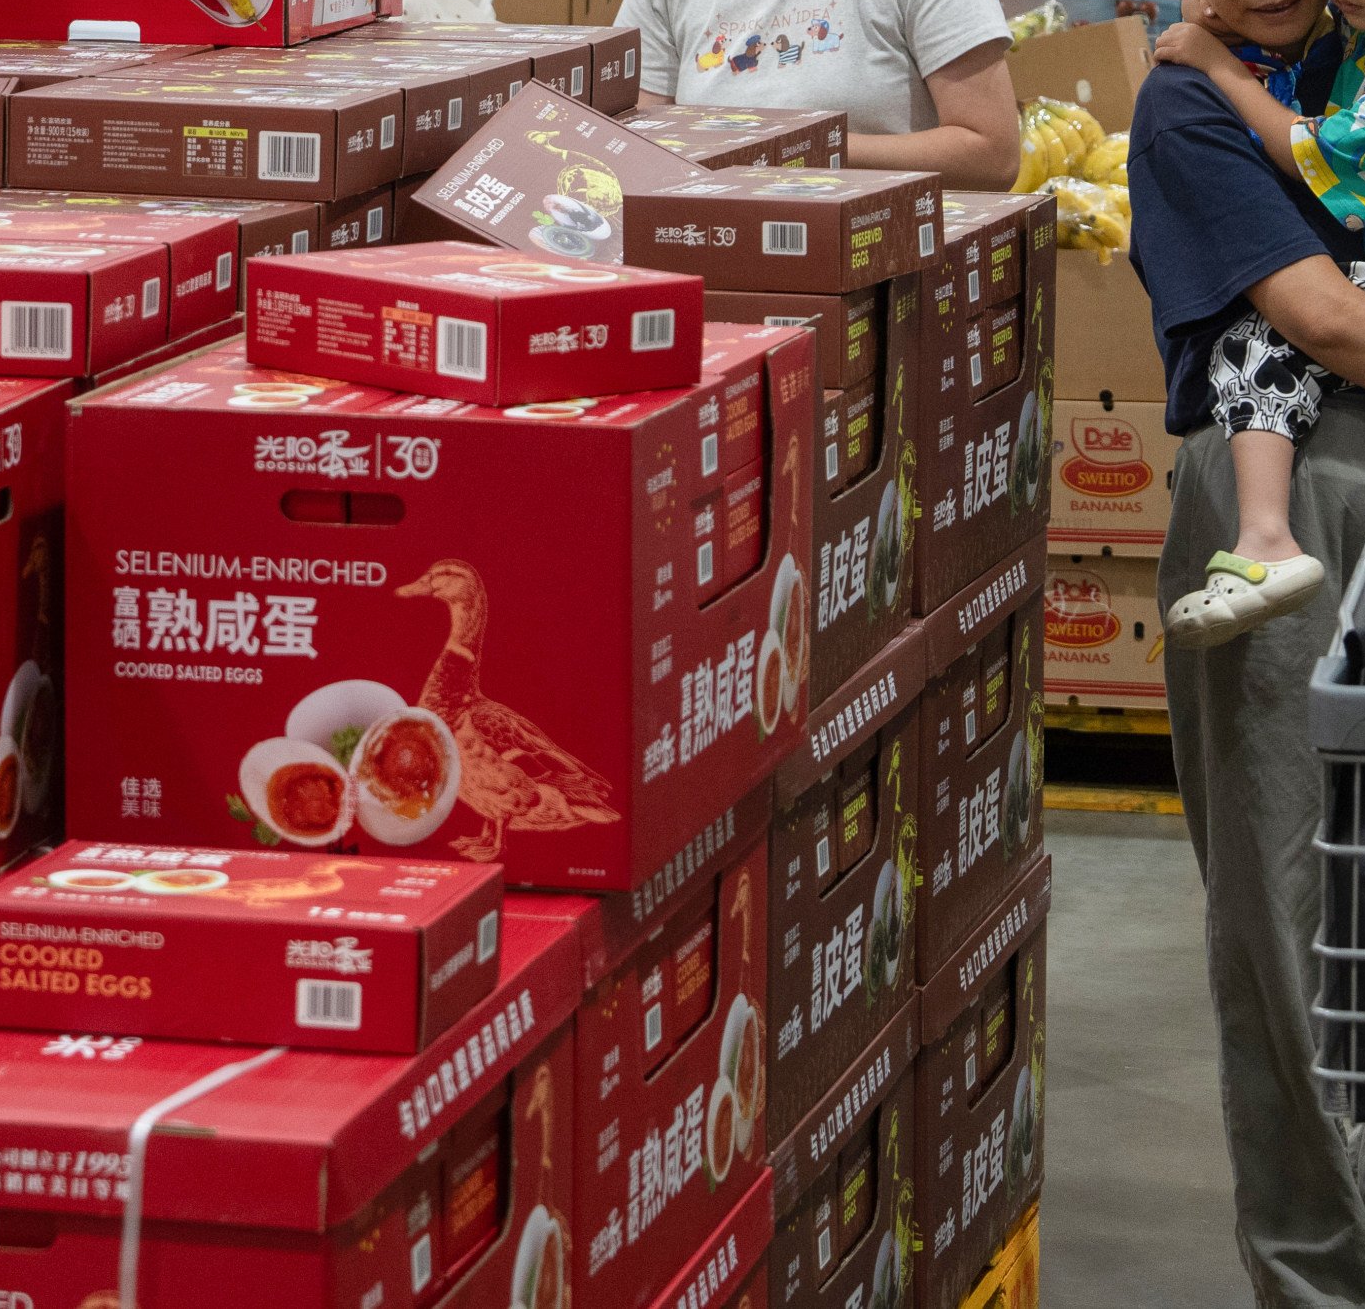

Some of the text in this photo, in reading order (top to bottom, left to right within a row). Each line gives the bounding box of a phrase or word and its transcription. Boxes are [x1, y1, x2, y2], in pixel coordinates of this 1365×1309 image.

[770, 14, 791, 29] AN
[795, 7, 831, 24] IDEA
[435, 137, 505, 201] SELENIUM-ENRICHED
[851, 226, 883, 250] PRESERVED
[851, 251, 870, 270] EGGS
[991, 244, 1013, 265] PRESERVED
[991, 264, 1005, 283] EGGS
[847, 318, 870, 341] PRESERVED
[848, 341, 861, 362] EGGS
[993, 346, 1006, 366] EGGS
[847, 413, 869, 440] PRESERVED
[1083, 424, 1133, 450] Dole
[847, 437, 861, 459] EGGS
[255, 458, 316, 472] GOOSUN
[962, 420, 1011, 521] 富硒皮蛋
[1078, 469, 1138, 488] SWEETIO
[1070, 499, 1143, 513] BANANAS
[115, 549, 387, 587] SELENIUM-ENRICHED
[817, 514, 871, 633] 富硒皮蛋
[957, 558, 1028, 636] 与出口欧盟蛋品同品质
[112, 585, 319, 659] 富硒熟咸蛋
[1045, 620, 1105, 638] SWEETIO
[114, 661, 263, 684] COOKED SALTED EGGS
[680, 629, 756, 767] 富硒熟咸蛋
[811, 670, 898, 764] 与出口欧盟蛋品同品质
[120, 776, 162, 799] 佳选
[958, 767, 1001, 878] 富硒皮蛋
[810, 903, 865, 1035] 富硒皮蛋
[85, 973, 153, 999] EGGS
[961, 1108, 1006, 1231] 富硒皮蛋
